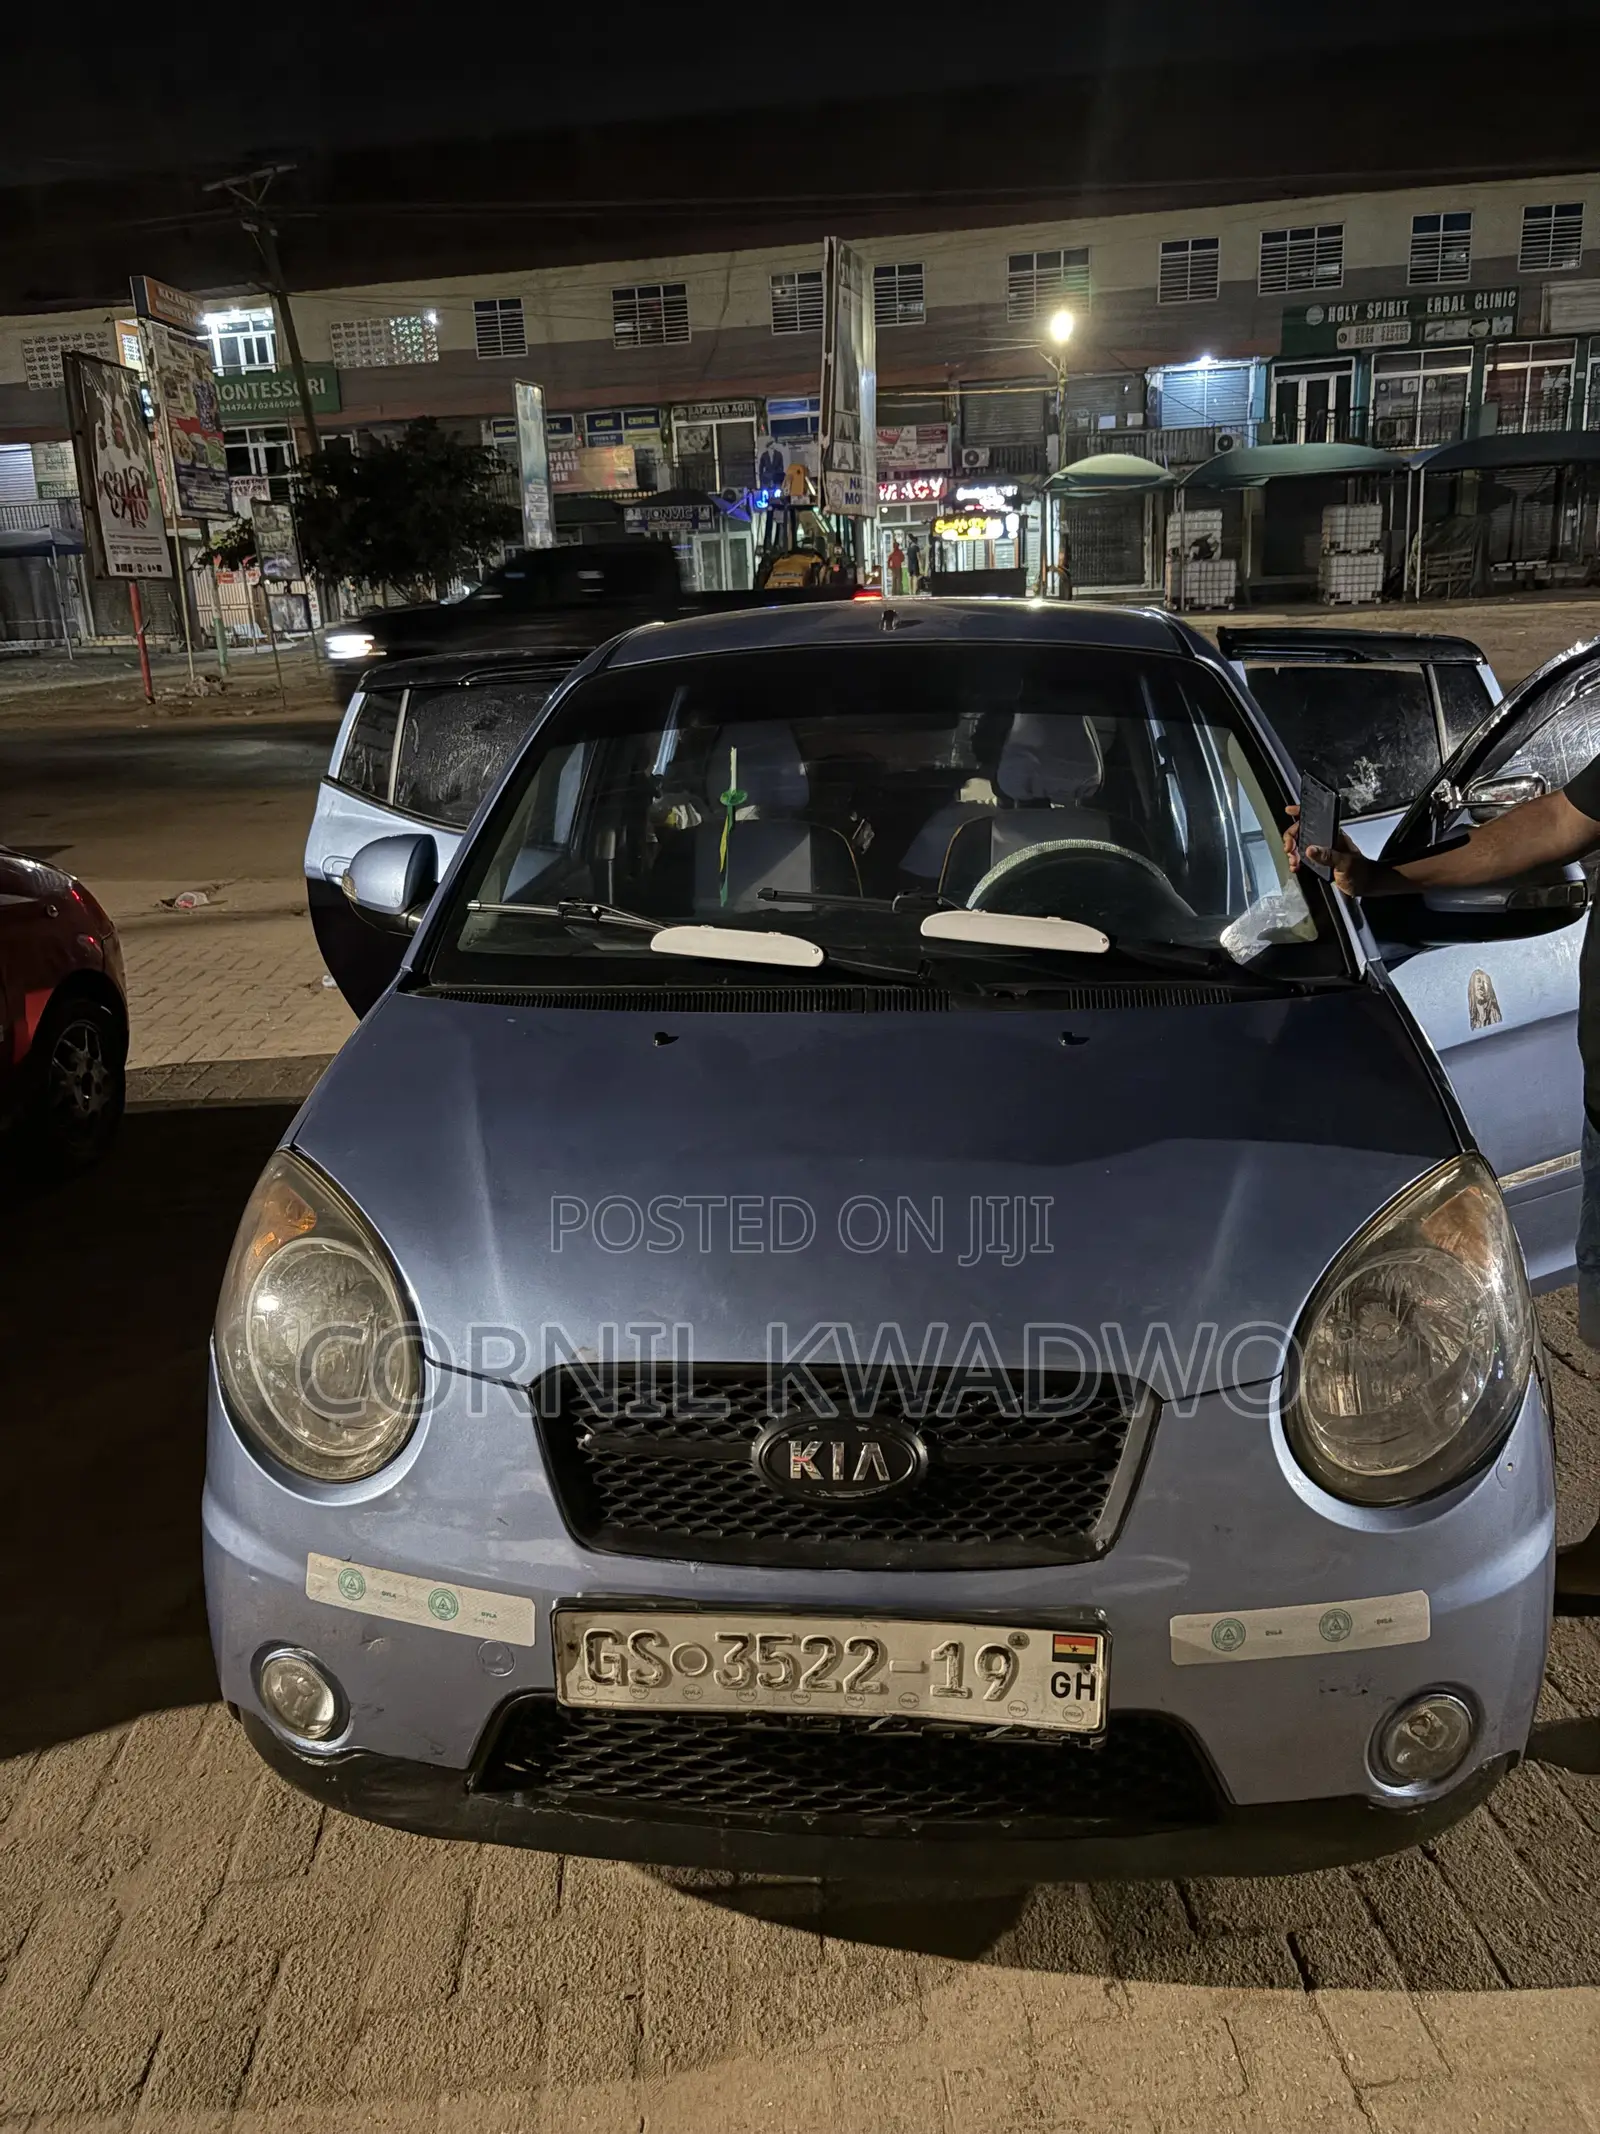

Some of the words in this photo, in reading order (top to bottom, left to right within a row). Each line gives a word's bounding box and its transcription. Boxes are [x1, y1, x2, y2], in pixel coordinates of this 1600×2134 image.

[1327, 305, 1358, 323] HOLY
[1366, 300, 1410, 320] SPIRIT
[1474, 290, 1517, 310] CLINIC
[787, 1440, 891, 1481] KIA
[1050, 1670, 1097, 1702] GH
